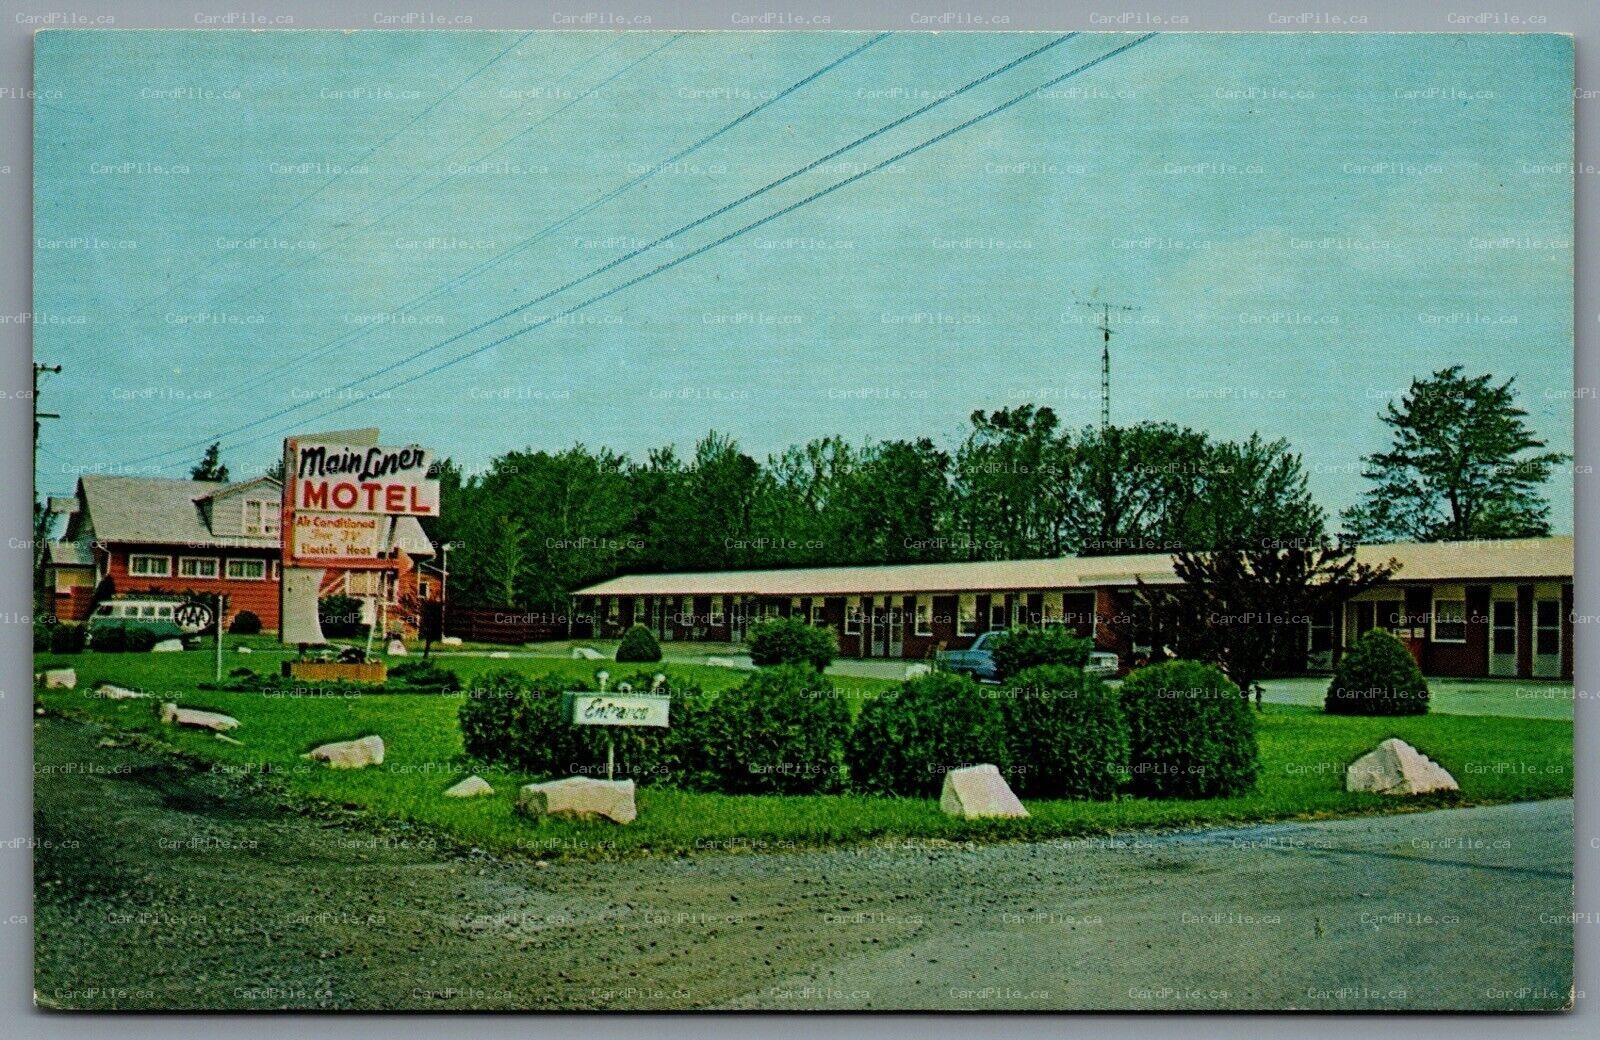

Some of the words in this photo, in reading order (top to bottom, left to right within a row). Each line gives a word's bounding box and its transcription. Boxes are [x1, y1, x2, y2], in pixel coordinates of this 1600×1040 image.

[303, 480, 431, 512] MOTEL
[313, 516, 375, 529] Conditioned
[302, 543, 337, 555] Electric
[346, 544, 371, 556] Heat
